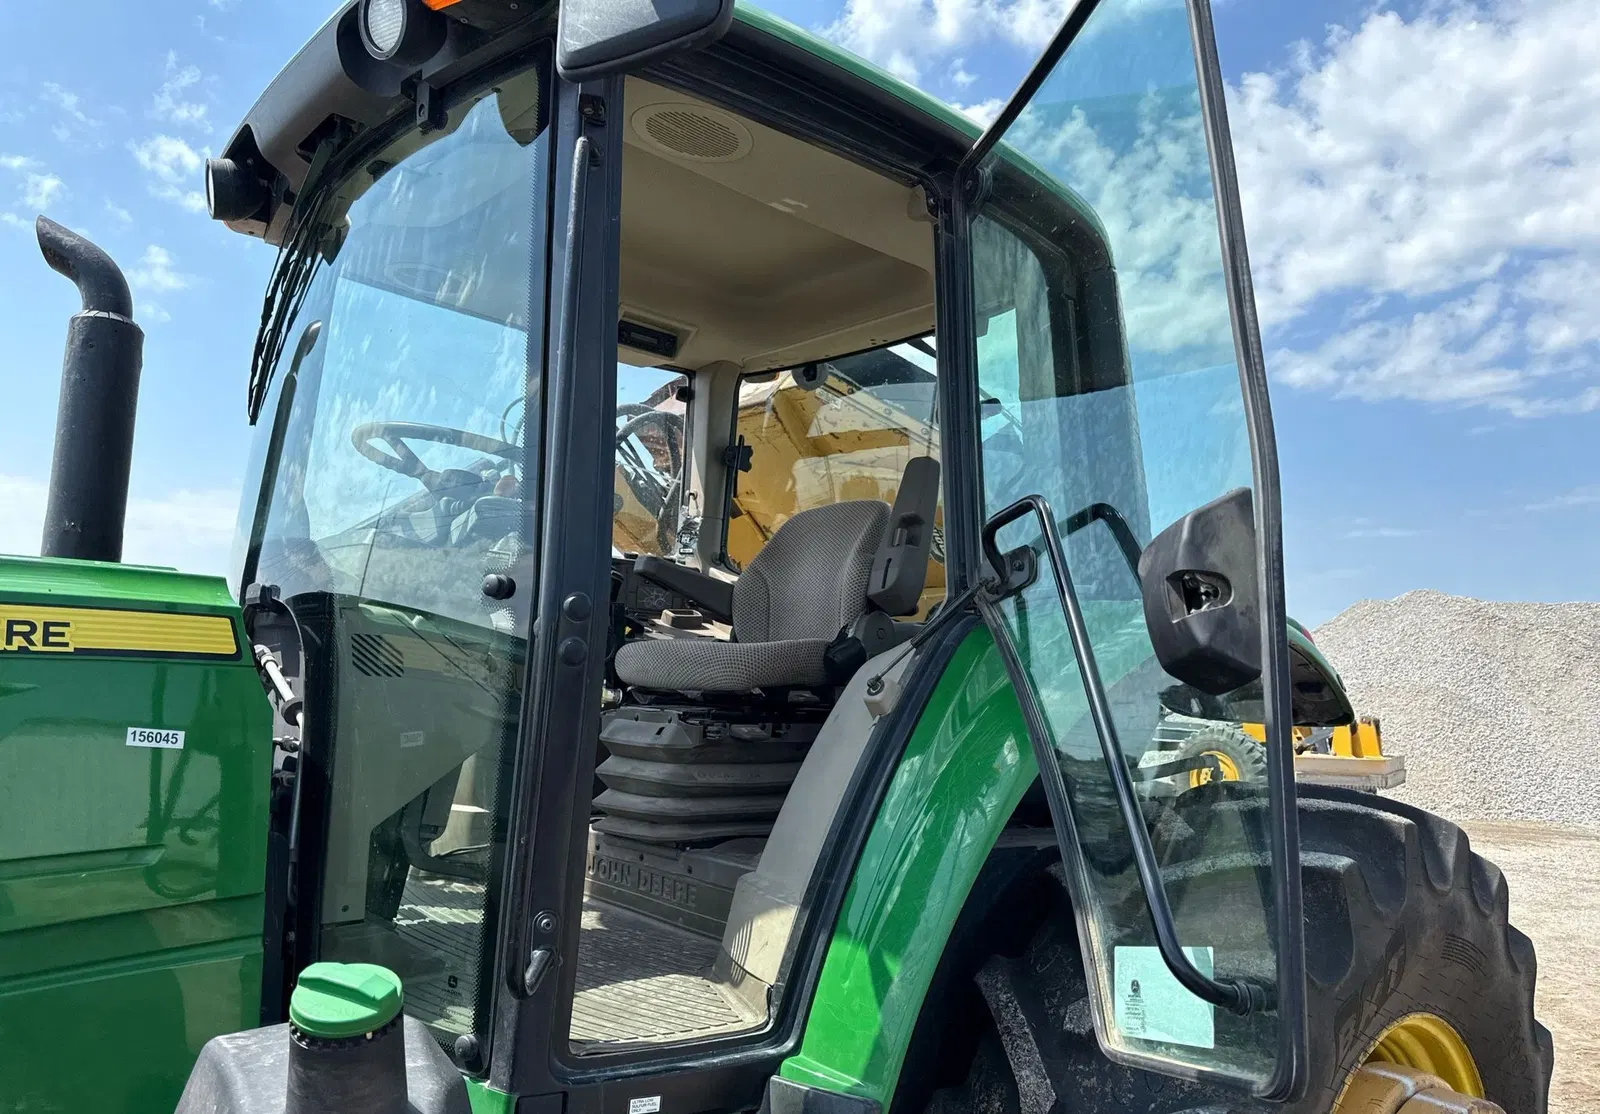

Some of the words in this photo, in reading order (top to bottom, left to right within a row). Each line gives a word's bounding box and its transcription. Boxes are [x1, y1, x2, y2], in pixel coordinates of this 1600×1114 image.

[131, 730, 179, 745] 156045
[588, 856, 632, 886] JOHN
[637, 868, 697, 907] DEERE
